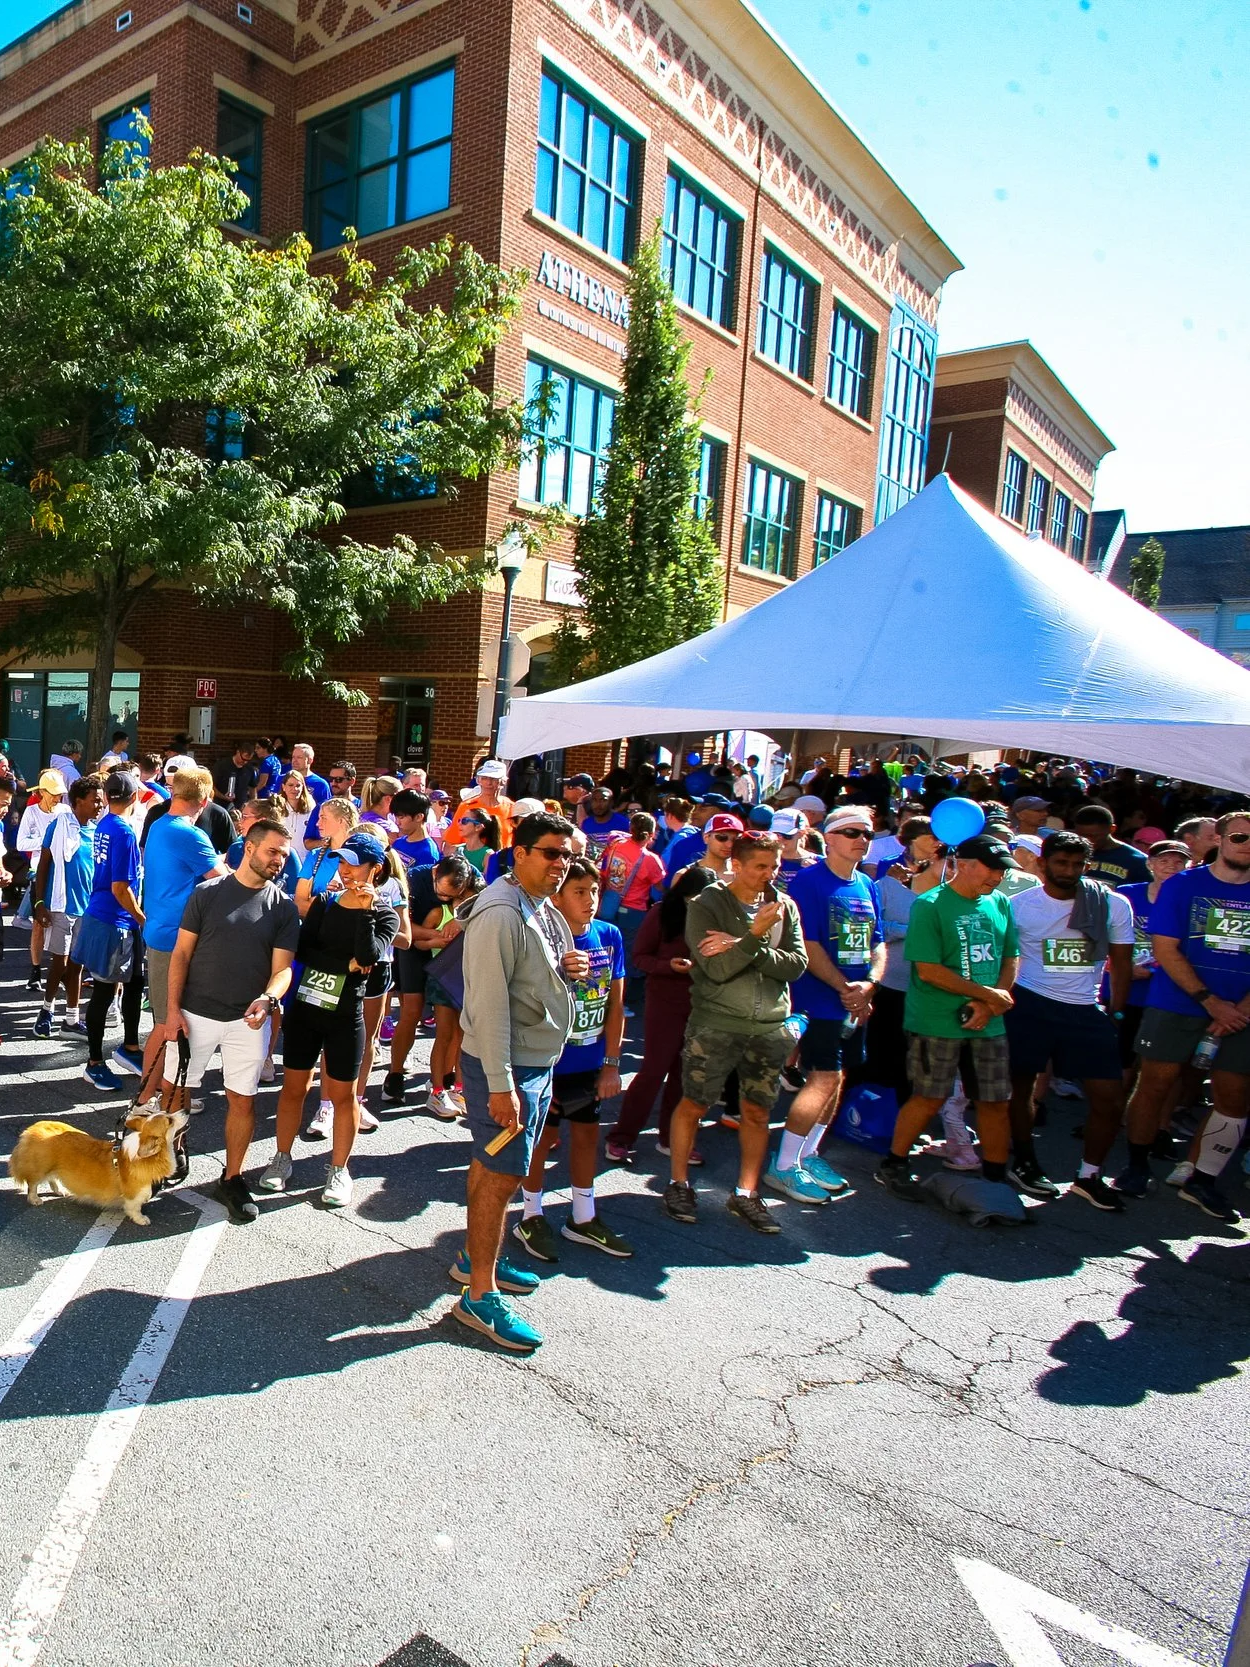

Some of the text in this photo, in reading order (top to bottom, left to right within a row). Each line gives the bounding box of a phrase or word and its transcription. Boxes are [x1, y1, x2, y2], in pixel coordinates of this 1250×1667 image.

[198, 680, 215, 692] FDC
[424, 687, 435, 699] 50
[407, 745, 424, 753] clover
[1221, 902, 1250, 910] KENTLA
[956, 925, 967, 940] DAY
[1215, 918, 1250, 936] 422
[845, 932, 867, 948] 421
[970, 942, 994, 963] 5K
[306, 969, 338, 991] 225
[578, 1006, 605, 1028] 870
